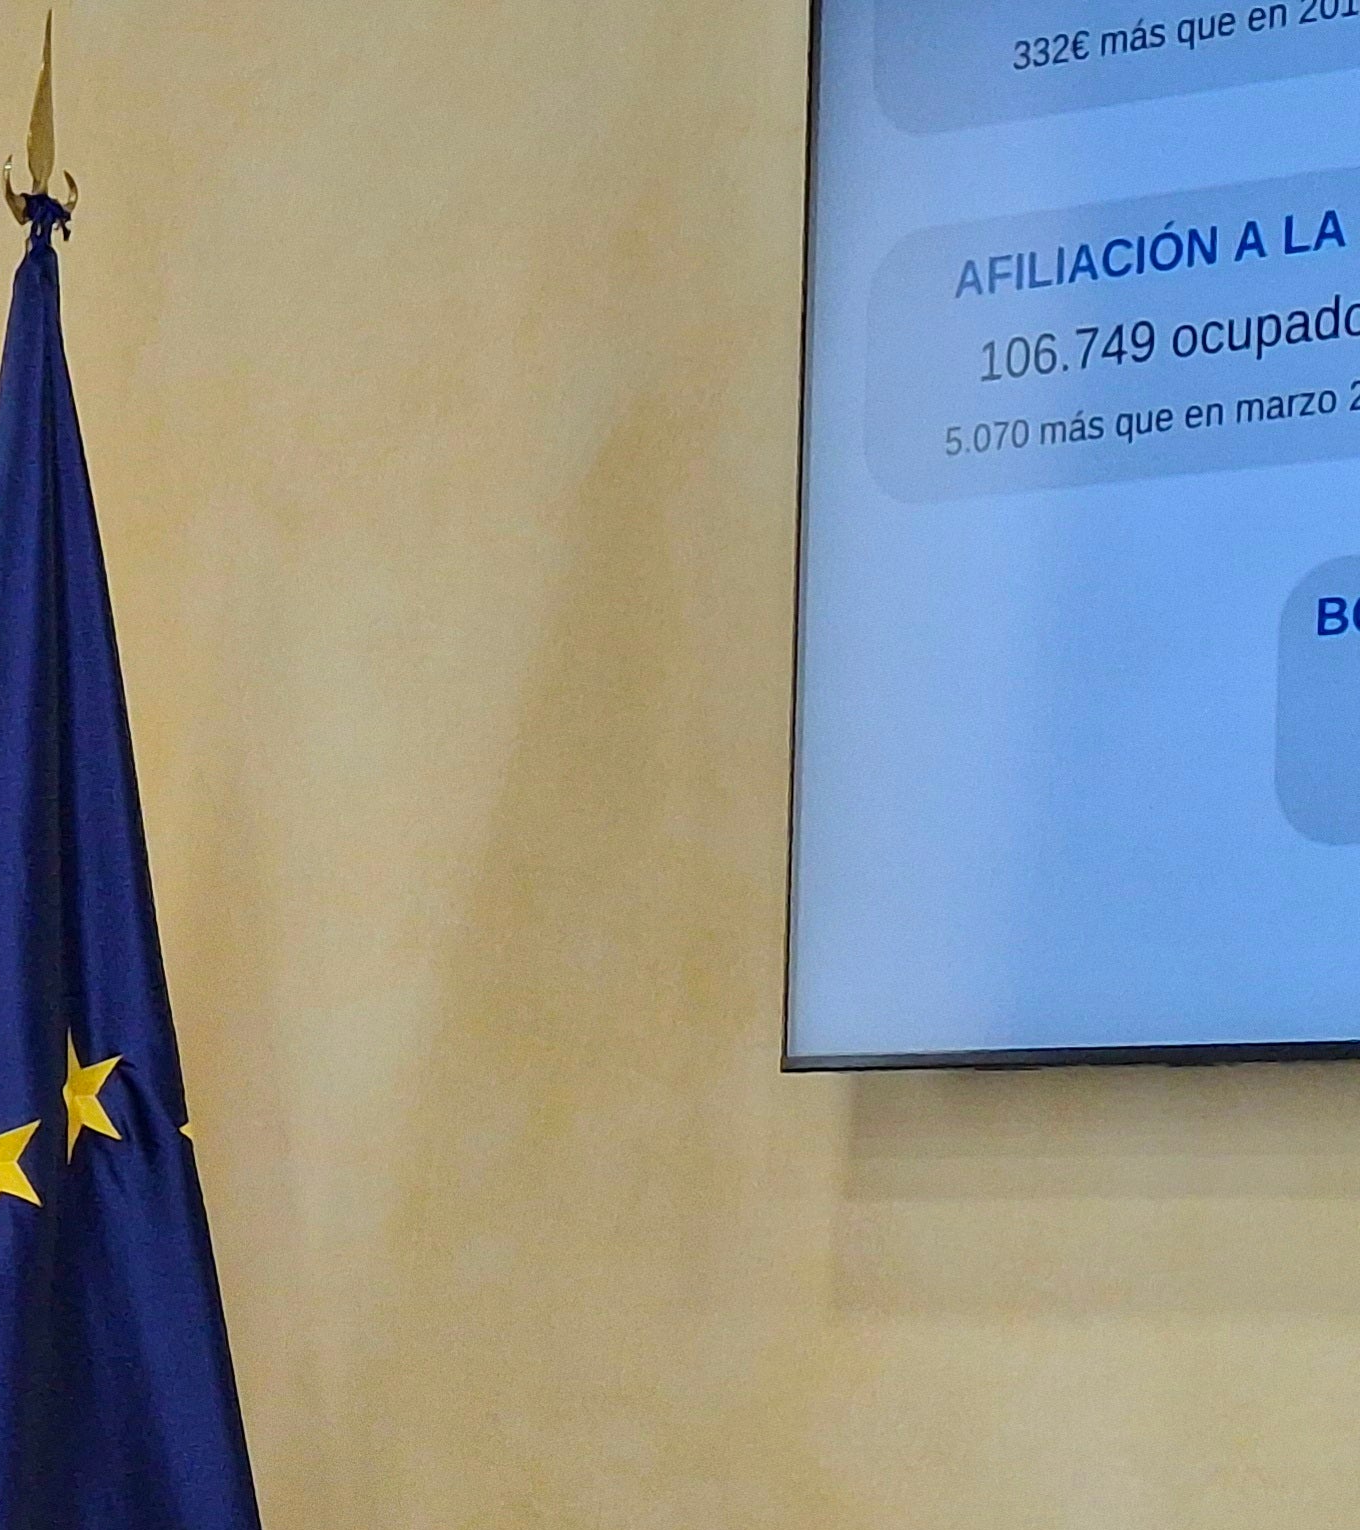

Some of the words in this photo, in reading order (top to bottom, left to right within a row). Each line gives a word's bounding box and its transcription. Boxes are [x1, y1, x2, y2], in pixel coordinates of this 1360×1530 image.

[1013, 30, 1090, 70] 332€
[1100, 18, 1166, 57] más
[1177, 12, 1236, 50] que
[1247, 3, 1287, 32] en
[955, 220, 1218, 299] AFILIACIÓN
[1234, 220, 1268, 262] A
[1284, 209, 1347, 255] LA
[980, 320, 1155, 382] 106.749
[945, 419, 1030, 456] 5.070
[1040, 410, 1105, 445] más
[1115, 408, 1174, 444] que
[1184, 403, 1224, 429] en
[1236, 389, 1337, 424] marzo
[1317, 596, 1360, 636] B
